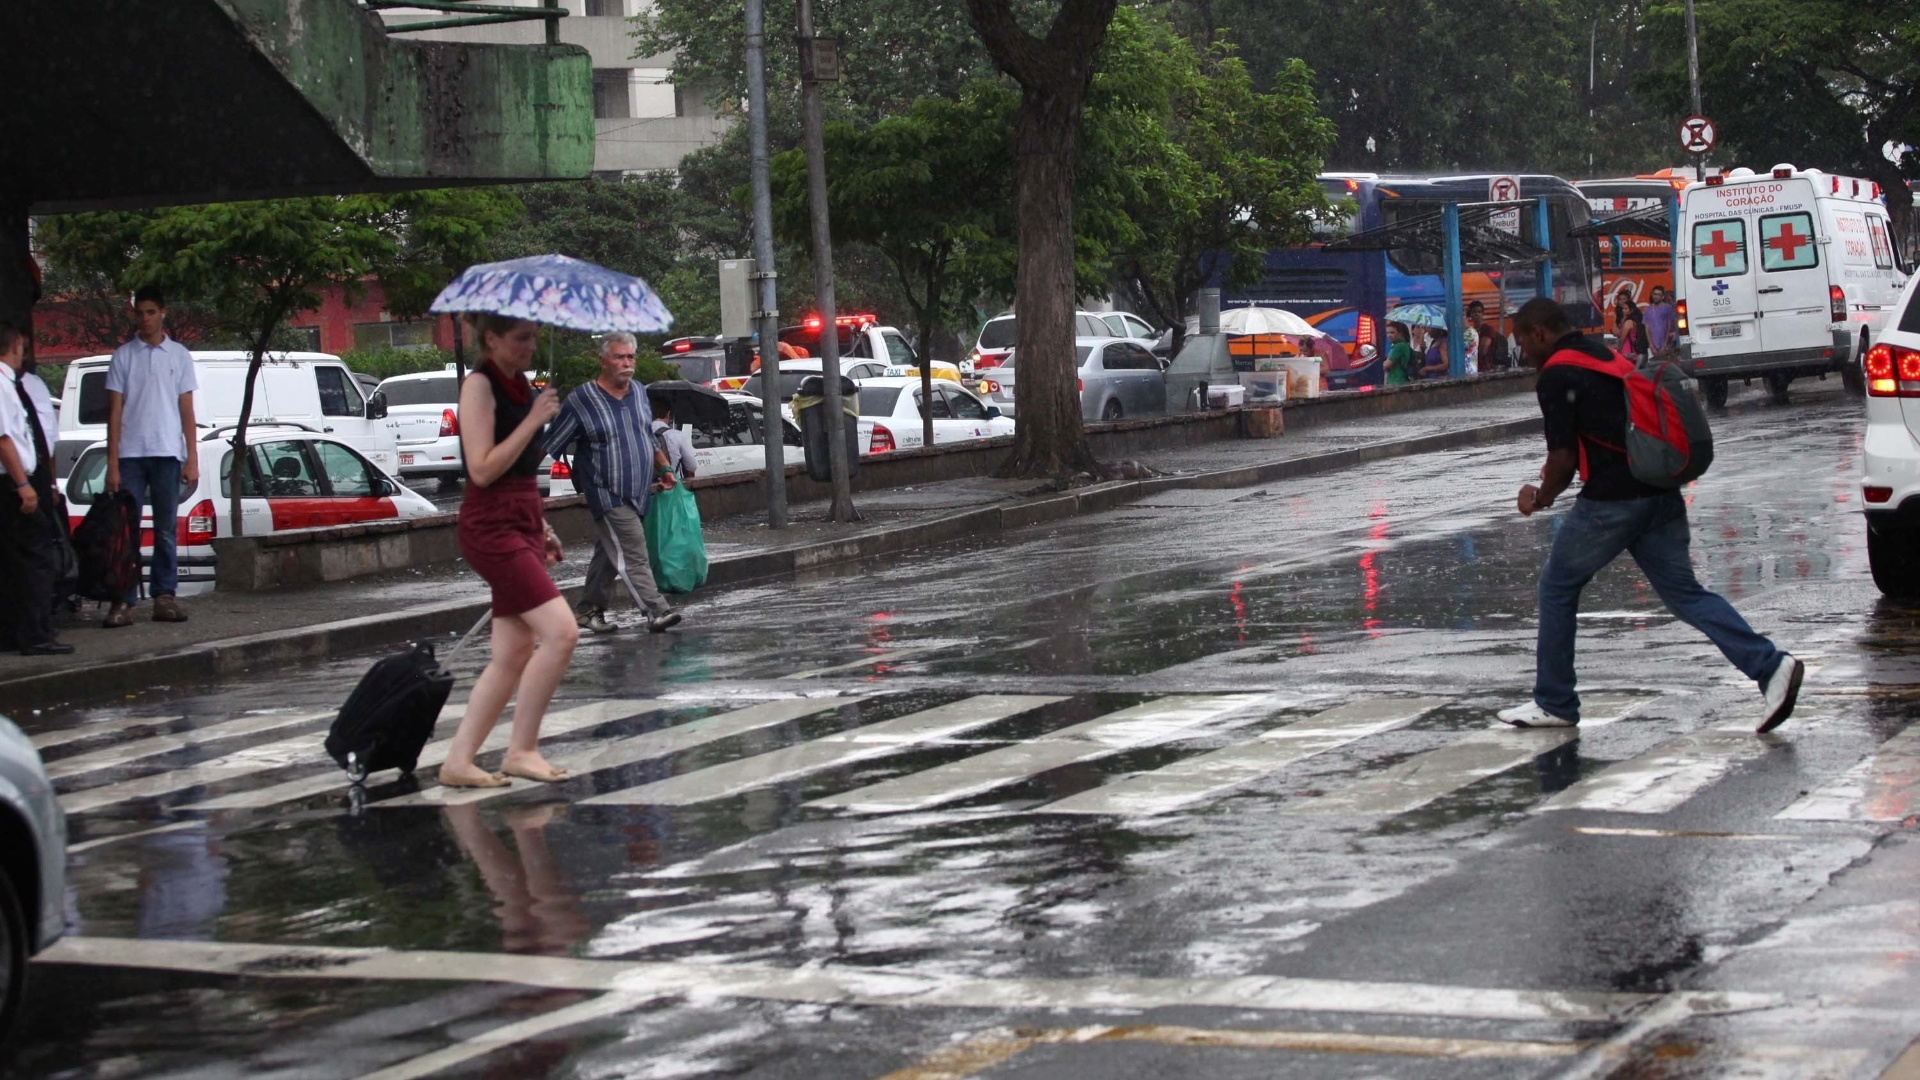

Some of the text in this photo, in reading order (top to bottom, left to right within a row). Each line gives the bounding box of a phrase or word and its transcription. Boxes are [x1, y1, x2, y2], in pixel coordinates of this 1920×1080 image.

[1716, 184, 1783, 198] INSTITUTO DO
[1725, 194, 1775, 207] CORAÇÃO
[1694, 211, 1727, 220] HOSPITAL
[1743, 206, 1774, 215] CLÍNICAS
[1780, 203, 1803, 212] FMUSP
[1712, 297, 1731, 307] SUS
[447, 363, 457, 371] TA
[886, 368, 901, 376] TAXI
